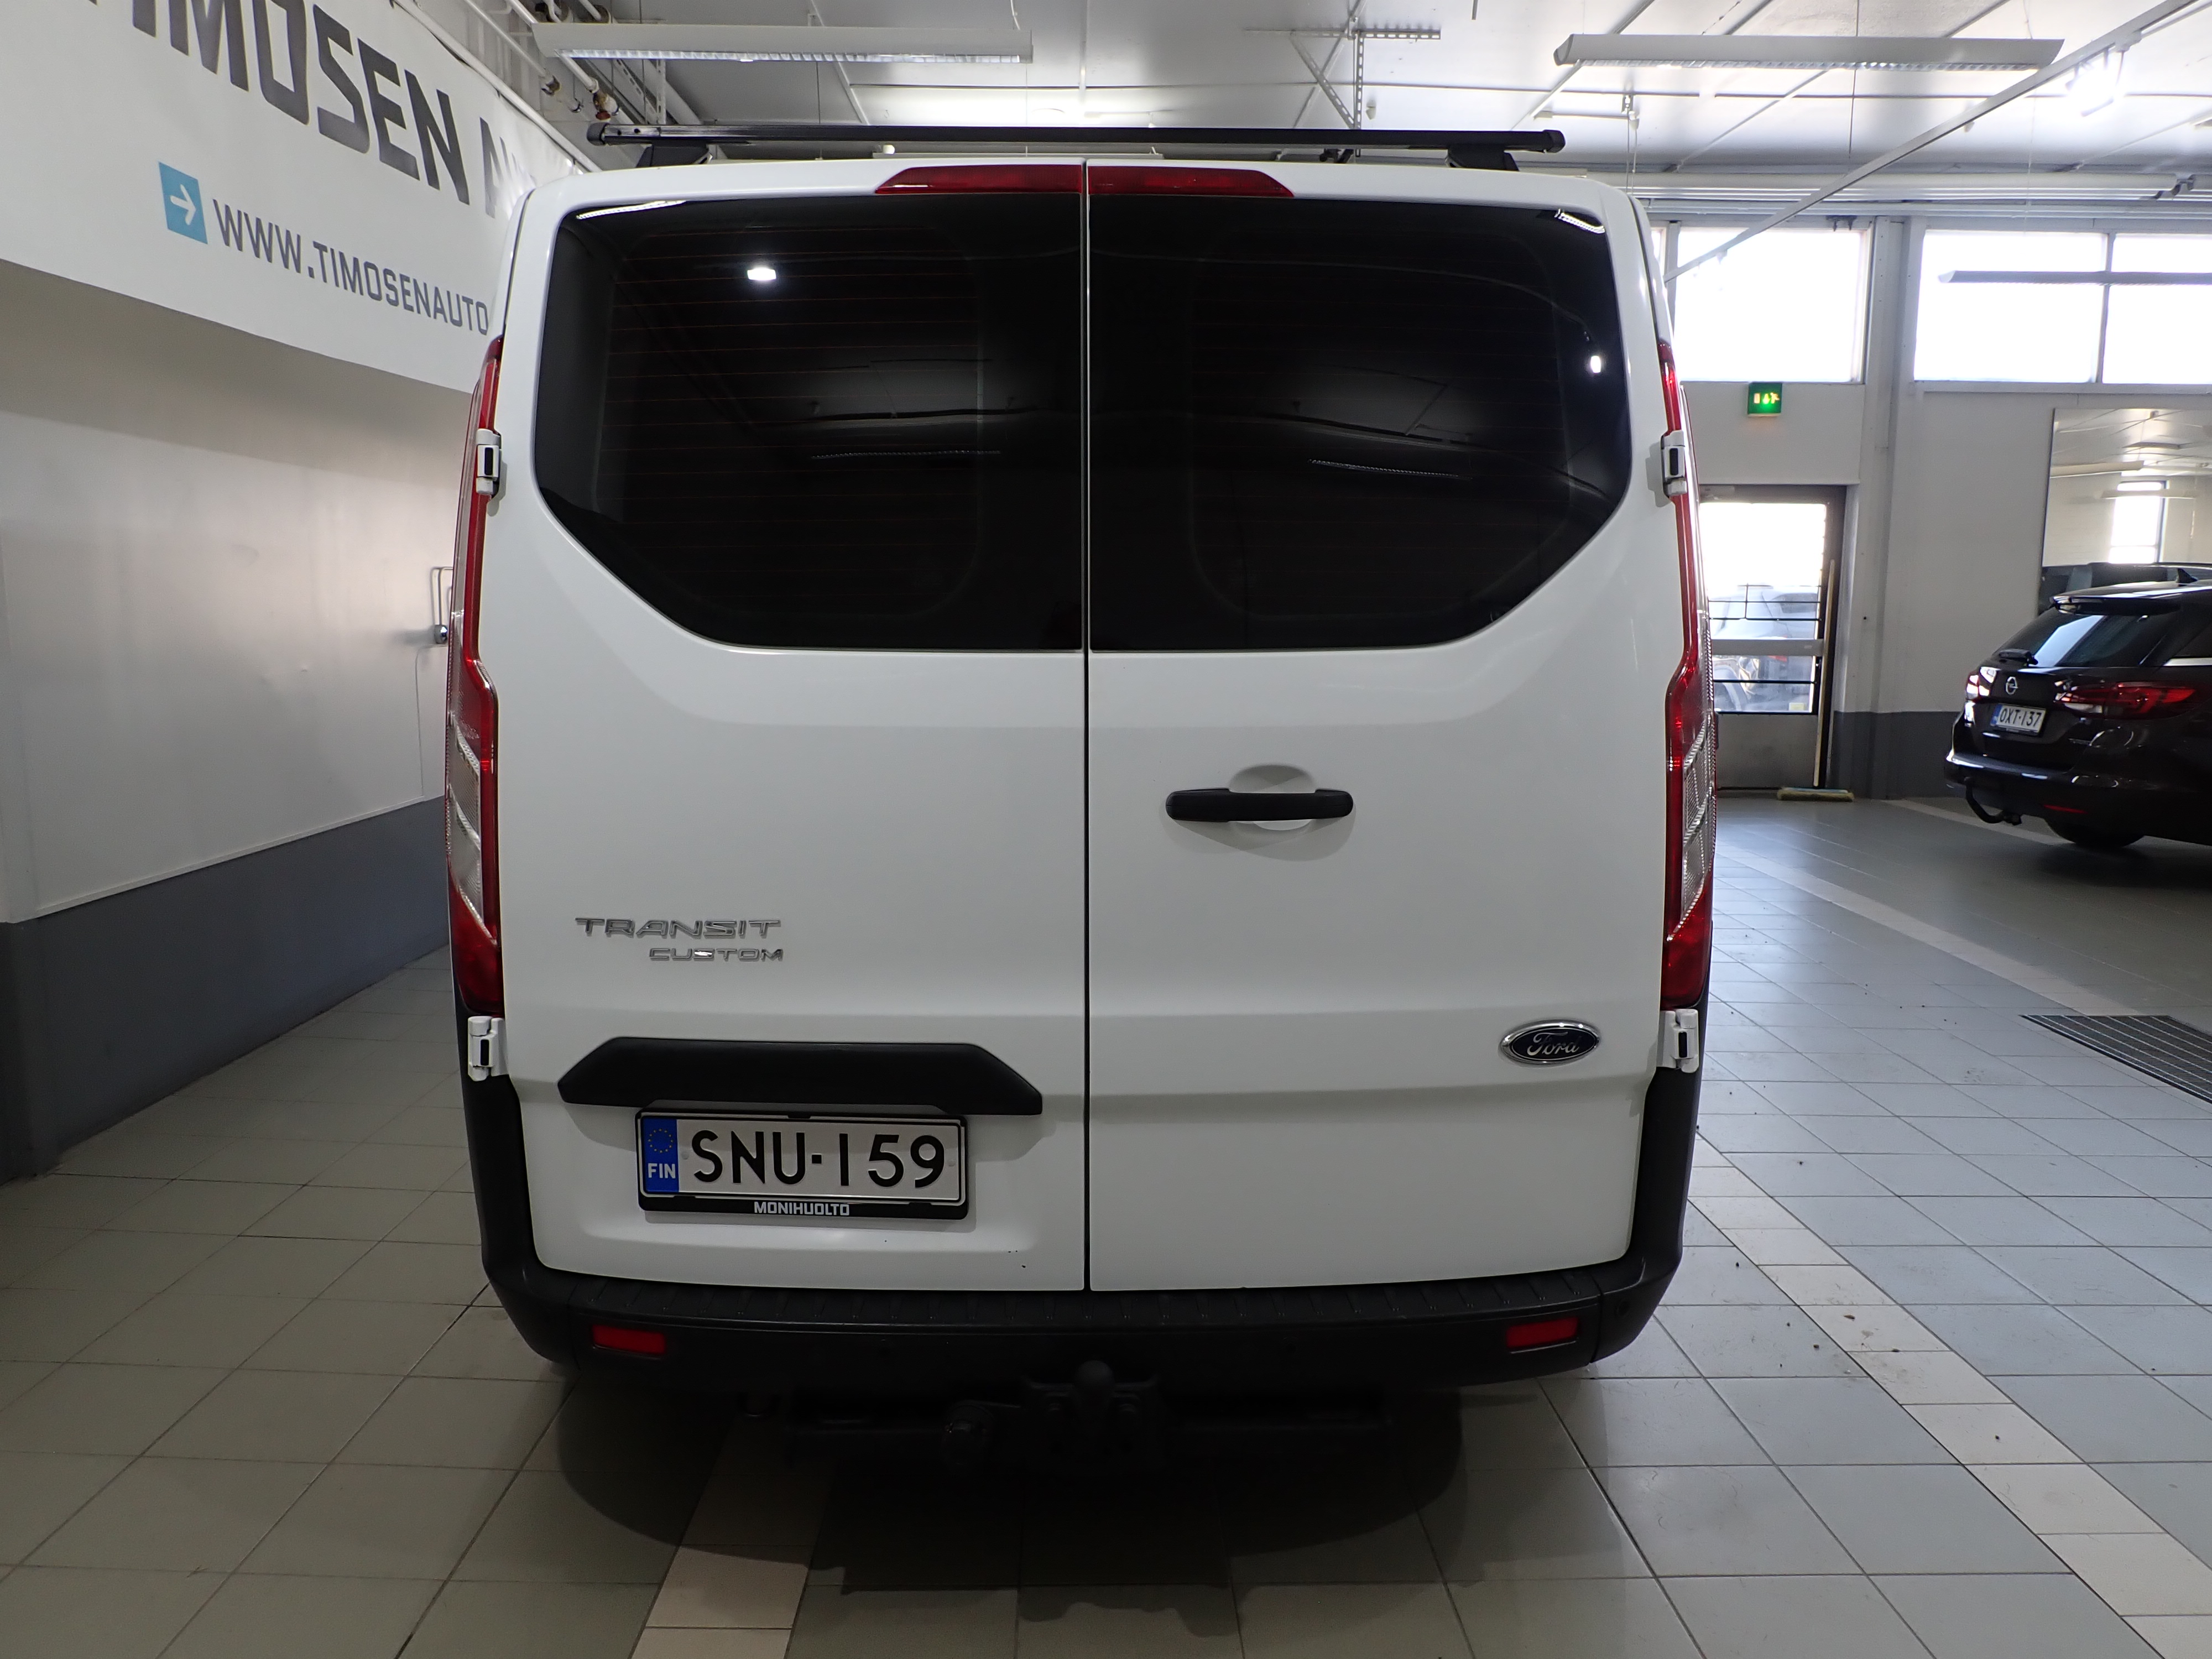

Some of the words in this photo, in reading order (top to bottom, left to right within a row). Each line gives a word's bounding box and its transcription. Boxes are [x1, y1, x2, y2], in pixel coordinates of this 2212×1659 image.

[2000, 708, 2042, 727] OXT-137
[575, 917, 781, 937] TRANSIT
[649, 948, 782, 961] CUSTOM
[1527, 1031, 1581, 1056] Ford
[691, 1130, 945, 1188] SNU-159
[648, 1163, 676, 1179] FIN
[754, 1201, 849, 1216] MONIHUOLTO
